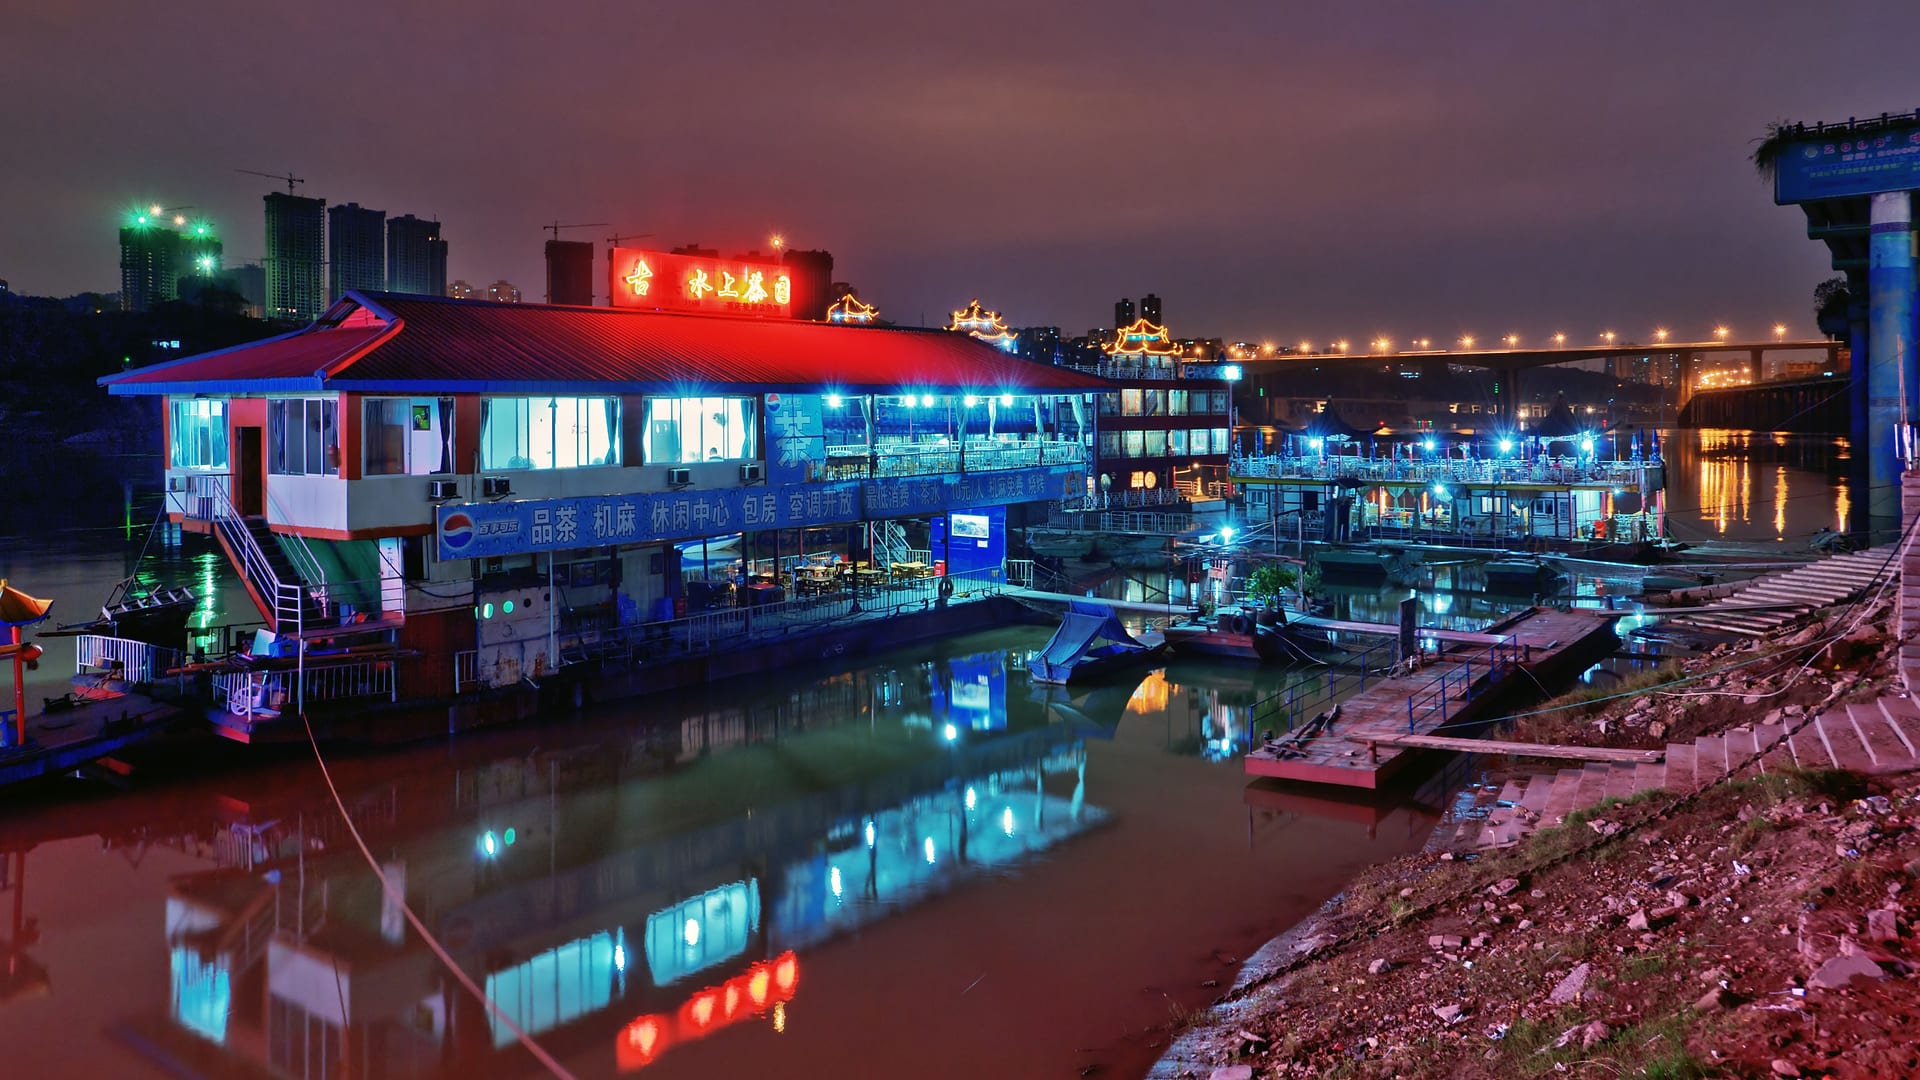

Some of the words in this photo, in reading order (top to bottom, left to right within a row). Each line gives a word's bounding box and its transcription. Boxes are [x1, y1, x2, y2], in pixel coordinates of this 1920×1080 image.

[774, 409, 812, 469] 茶
[479, 520, 519, 536] 百事可乐
[531, 506, 578, 545] 品茶
[593, 502, 636, 538] 机麻
[651, 497, 730, 534] 休闲中心
[742, 494, 776, 525] 包房
[789, 489, 854, 520] 空调开放
